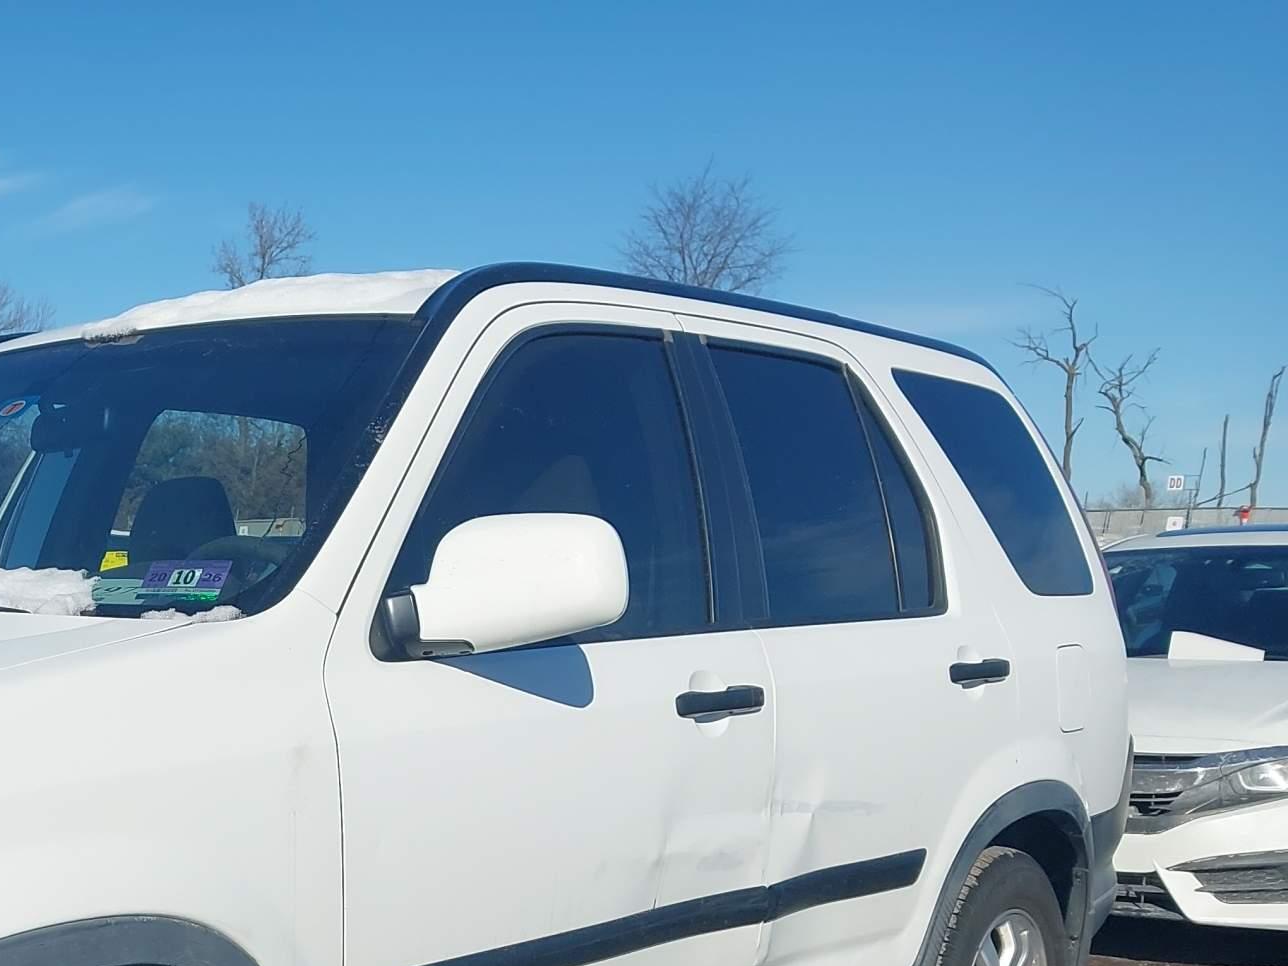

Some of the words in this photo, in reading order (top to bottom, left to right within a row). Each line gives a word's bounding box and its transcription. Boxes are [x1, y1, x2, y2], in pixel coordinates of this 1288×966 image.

[148, 572, 168, 582] 20
[172, 569, 196, 585] 10
[201, 573, 222, 583] 26
